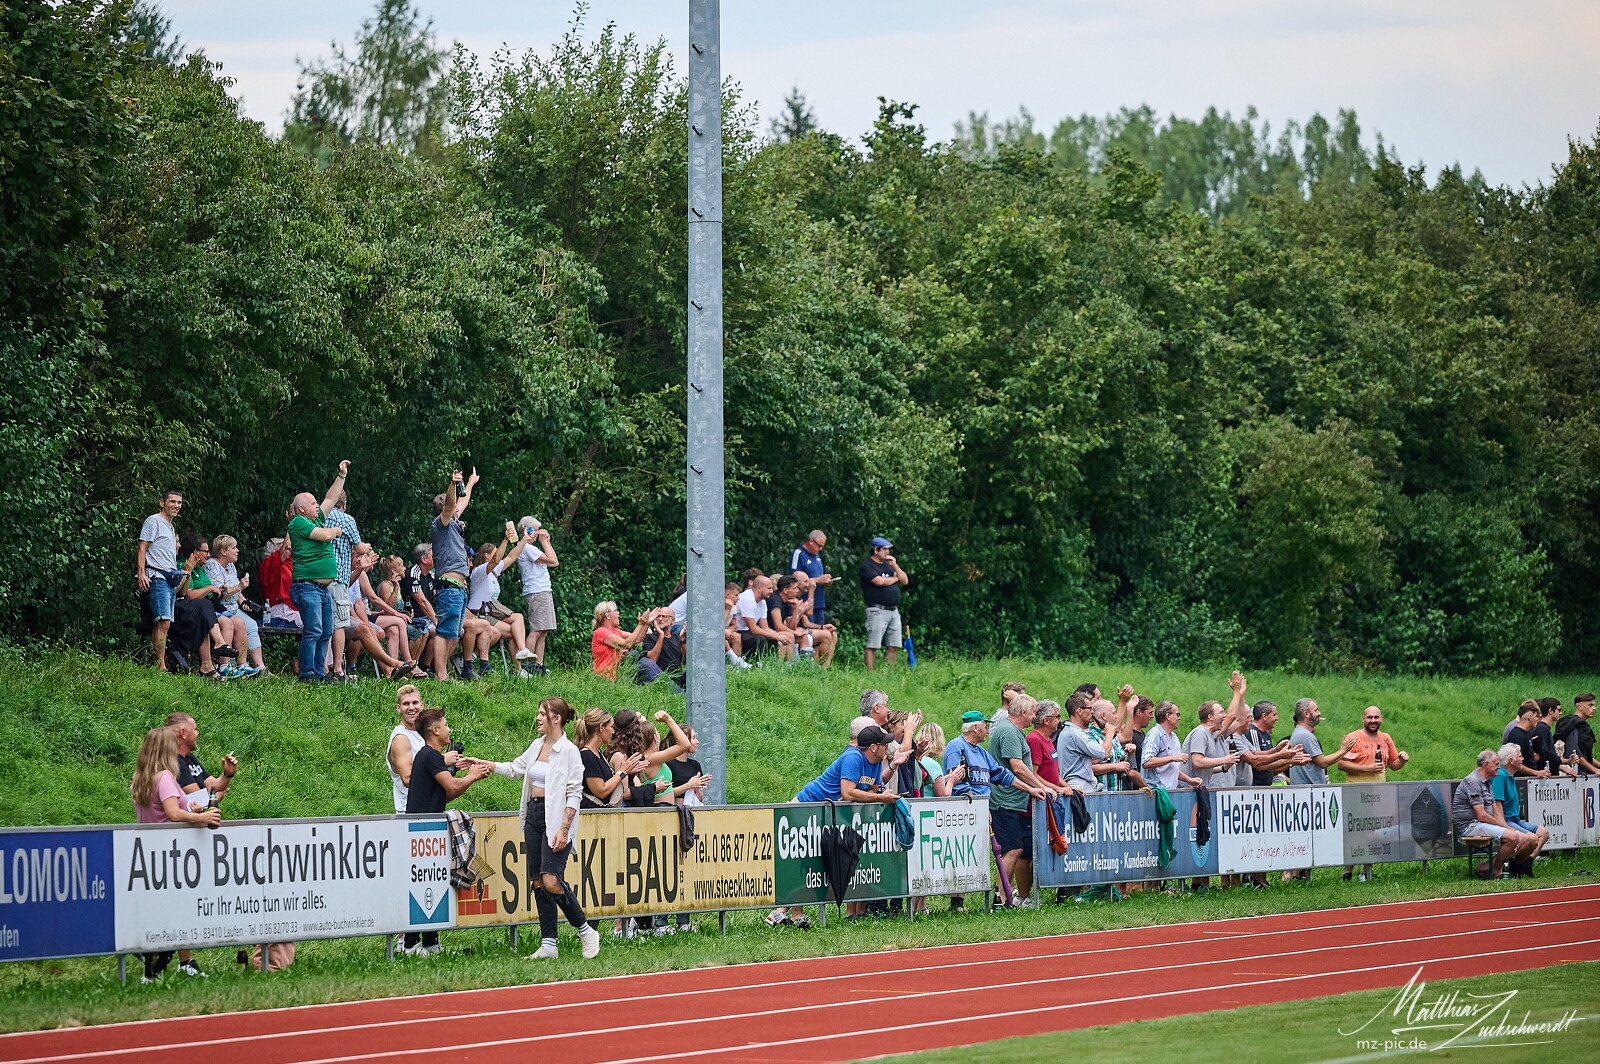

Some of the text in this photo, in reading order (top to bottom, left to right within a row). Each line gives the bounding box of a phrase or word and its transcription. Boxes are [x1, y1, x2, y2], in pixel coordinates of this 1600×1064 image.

[936, 809, 976, 827] Glaserei
[1221, 791, 1326, 835] Heizöl Nickolai
[411, 837, 447, 857] BOSCH
[694, 833, 710, 863] Tel.
[713, 833, 718, 863] 0
[721, 833, 731, 862] 86
[734, 833, 745, 862] 87
[753, 832, 759, 861] 2
[761, 832, 772, 860] 22
[919, 810, 978, 871] FRANK
[128, 824, 389, 891] Auto Buchwinkler
[1064, 854, 1089, 873] Sanitär
[1093, 853, 1119, 874] Heizung
[411, 862, 448, 883] Service
[806, 867, 821, 888] das
[694, 871, 773, 900] www.stoecklbau.de
[198, 890, 327, 917] Für Ihr Auto tun wir alles.
[190, 928, 198, 940] 15
[203, 926, 222, 939] 83410
[224, 925, 244, 938] Laufen
[248, 924, 257, 936] Tel.
[259, 923, 263, 936] 0
[265, 922, 272, 935] 86
[291, 921, 298, 933] 33
[302, 916, 374, 932] www.auto-buchwinkler.de
